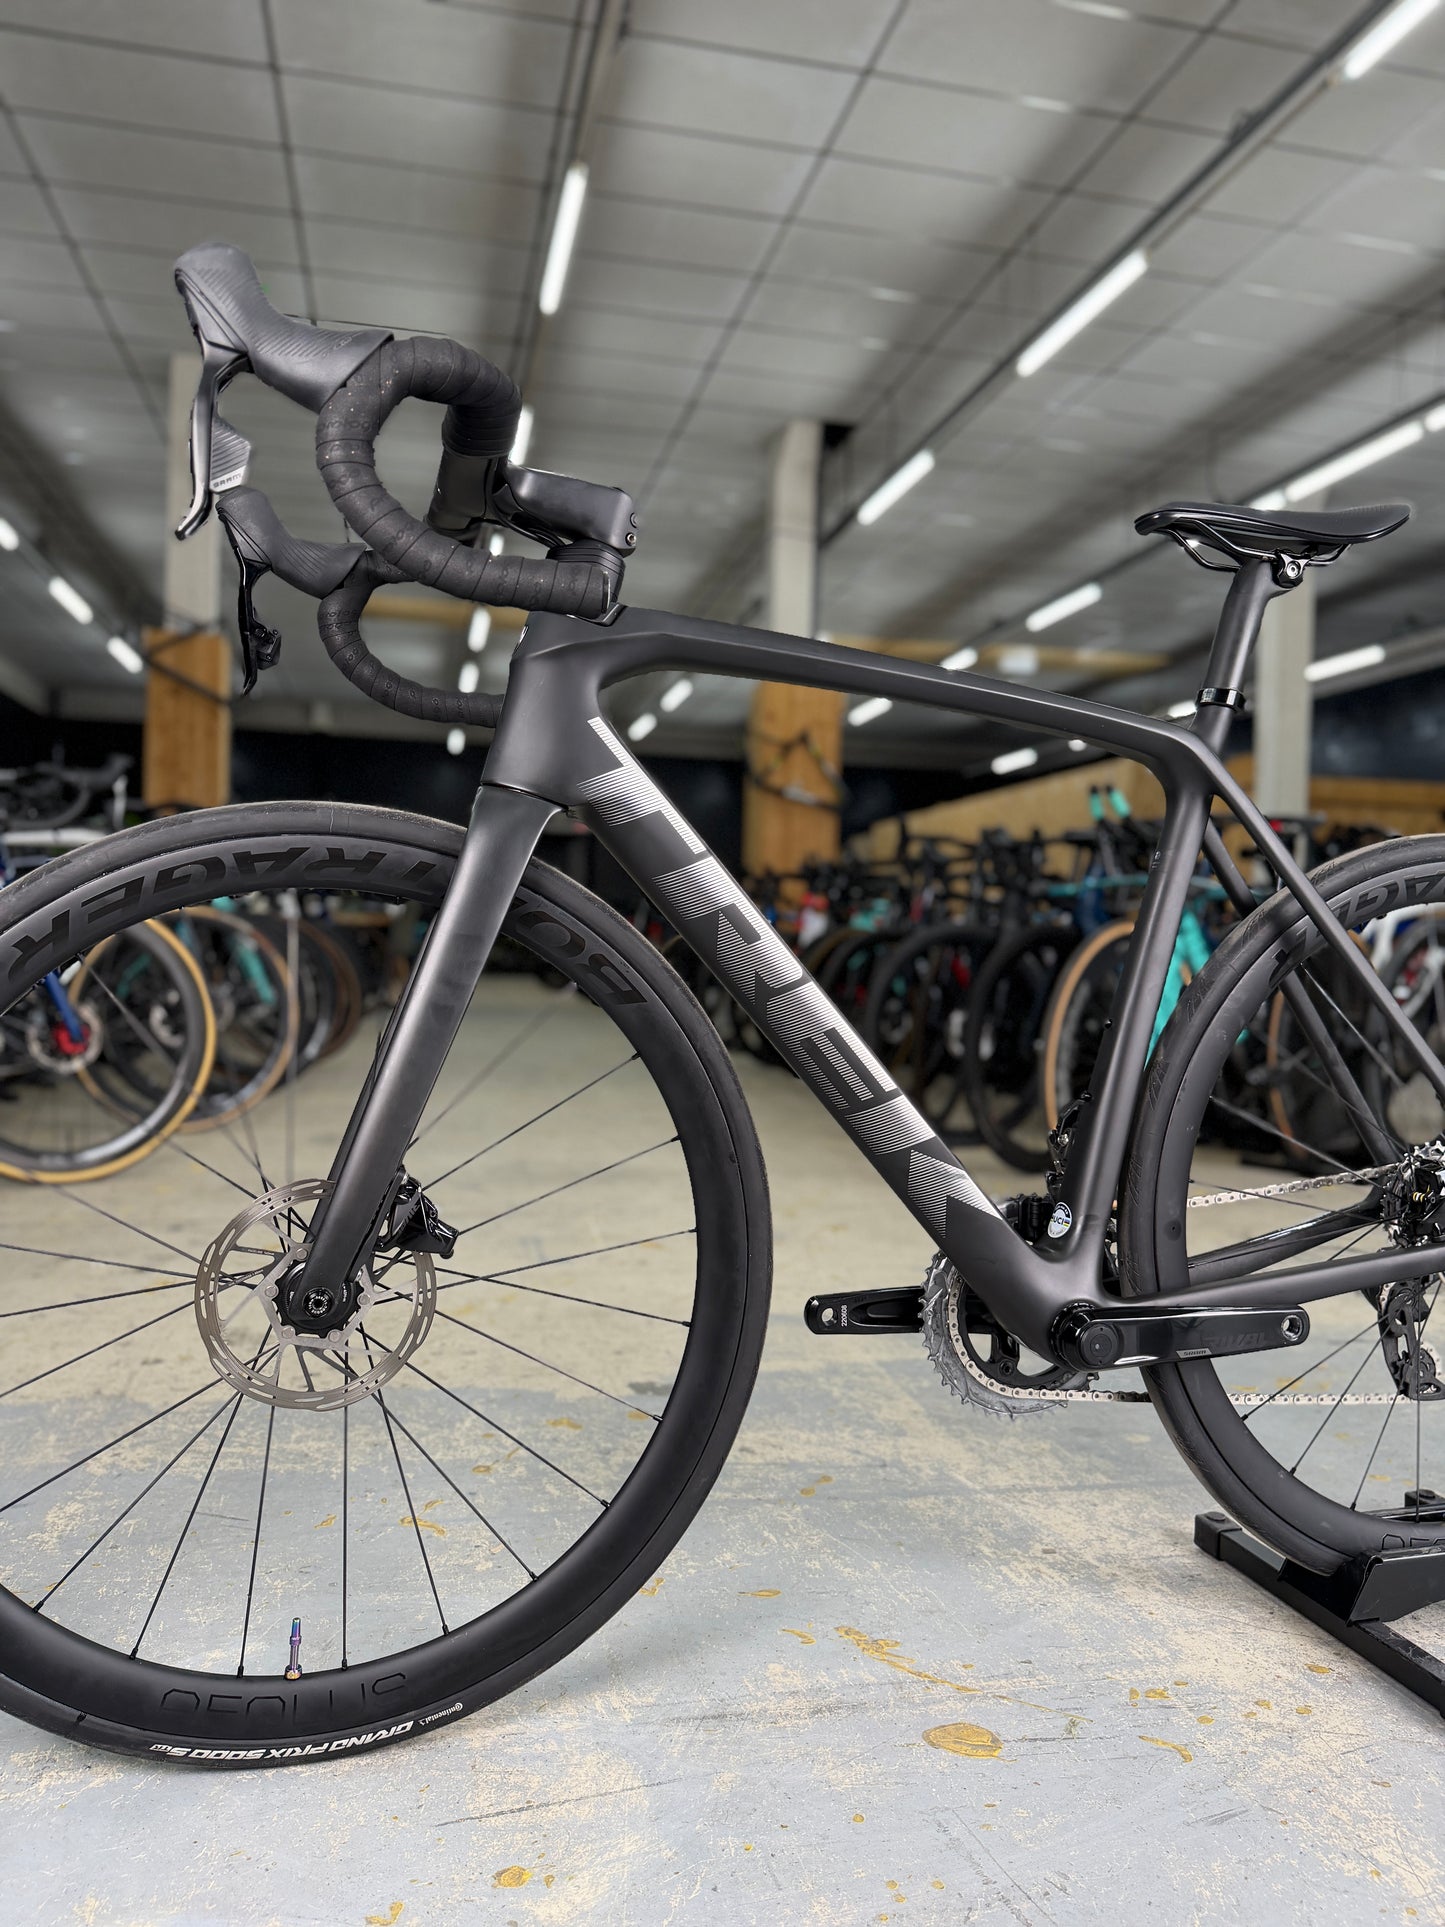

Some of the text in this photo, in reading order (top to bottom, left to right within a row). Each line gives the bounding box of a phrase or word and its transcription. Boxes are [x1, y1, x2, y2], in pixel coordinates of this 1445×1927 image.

[213, 473, 242, 488] SRAM
[577, 716, 1003, 1239] TREK
[426, 1702, 464, 1724] Continental
[333, 1720, 414, 1749] GRAND
[191, 1748, 265, 1760] 5000
[265, 1742, 332, 1760] PRIX
